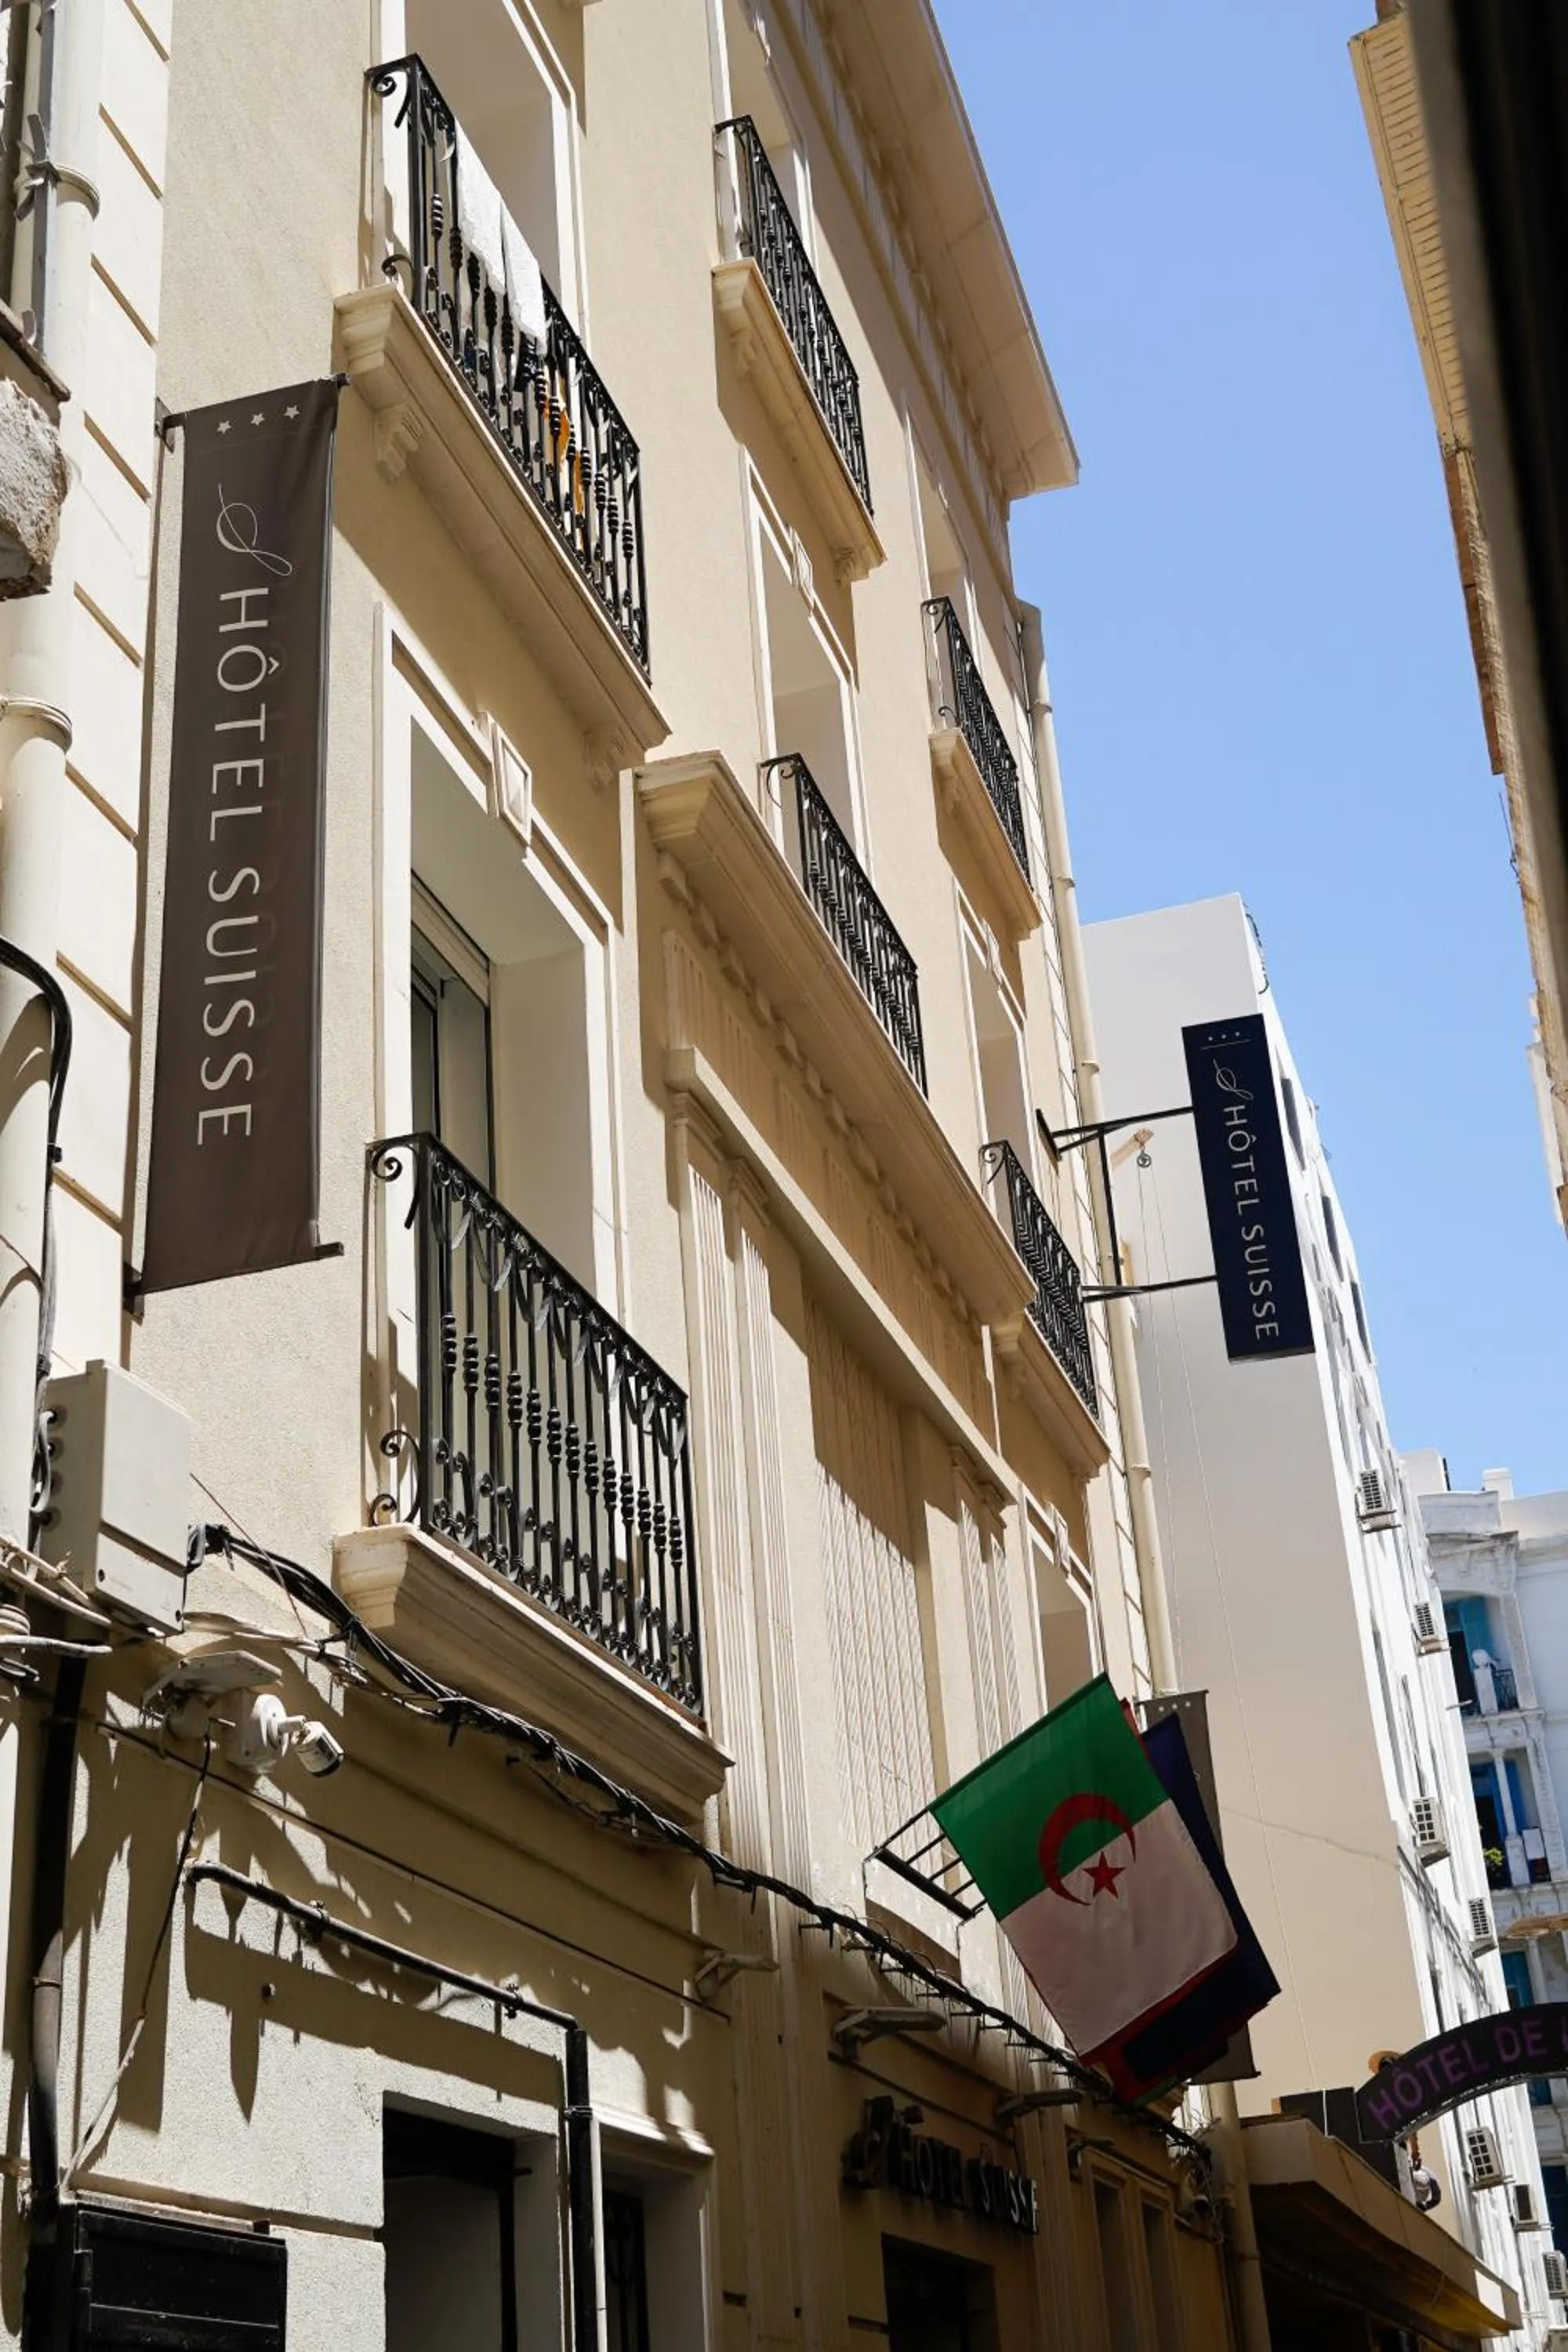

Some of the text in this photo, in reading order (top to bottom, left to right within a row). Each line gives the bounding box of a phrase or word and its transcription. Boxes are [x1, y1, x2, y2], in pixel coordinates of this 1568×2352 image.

[210, 586, 280, 841] HÔTEL
[197, 866, 260, 1145] SUISSE
[1223, 1105, 1258, 1215] HÔTEL
[1241, 1225, 1279, 1340] SUISSE
[1367, 2037, 1491, 2131] HÔTEL
[1494, 2020, 1548, 2063] DE
